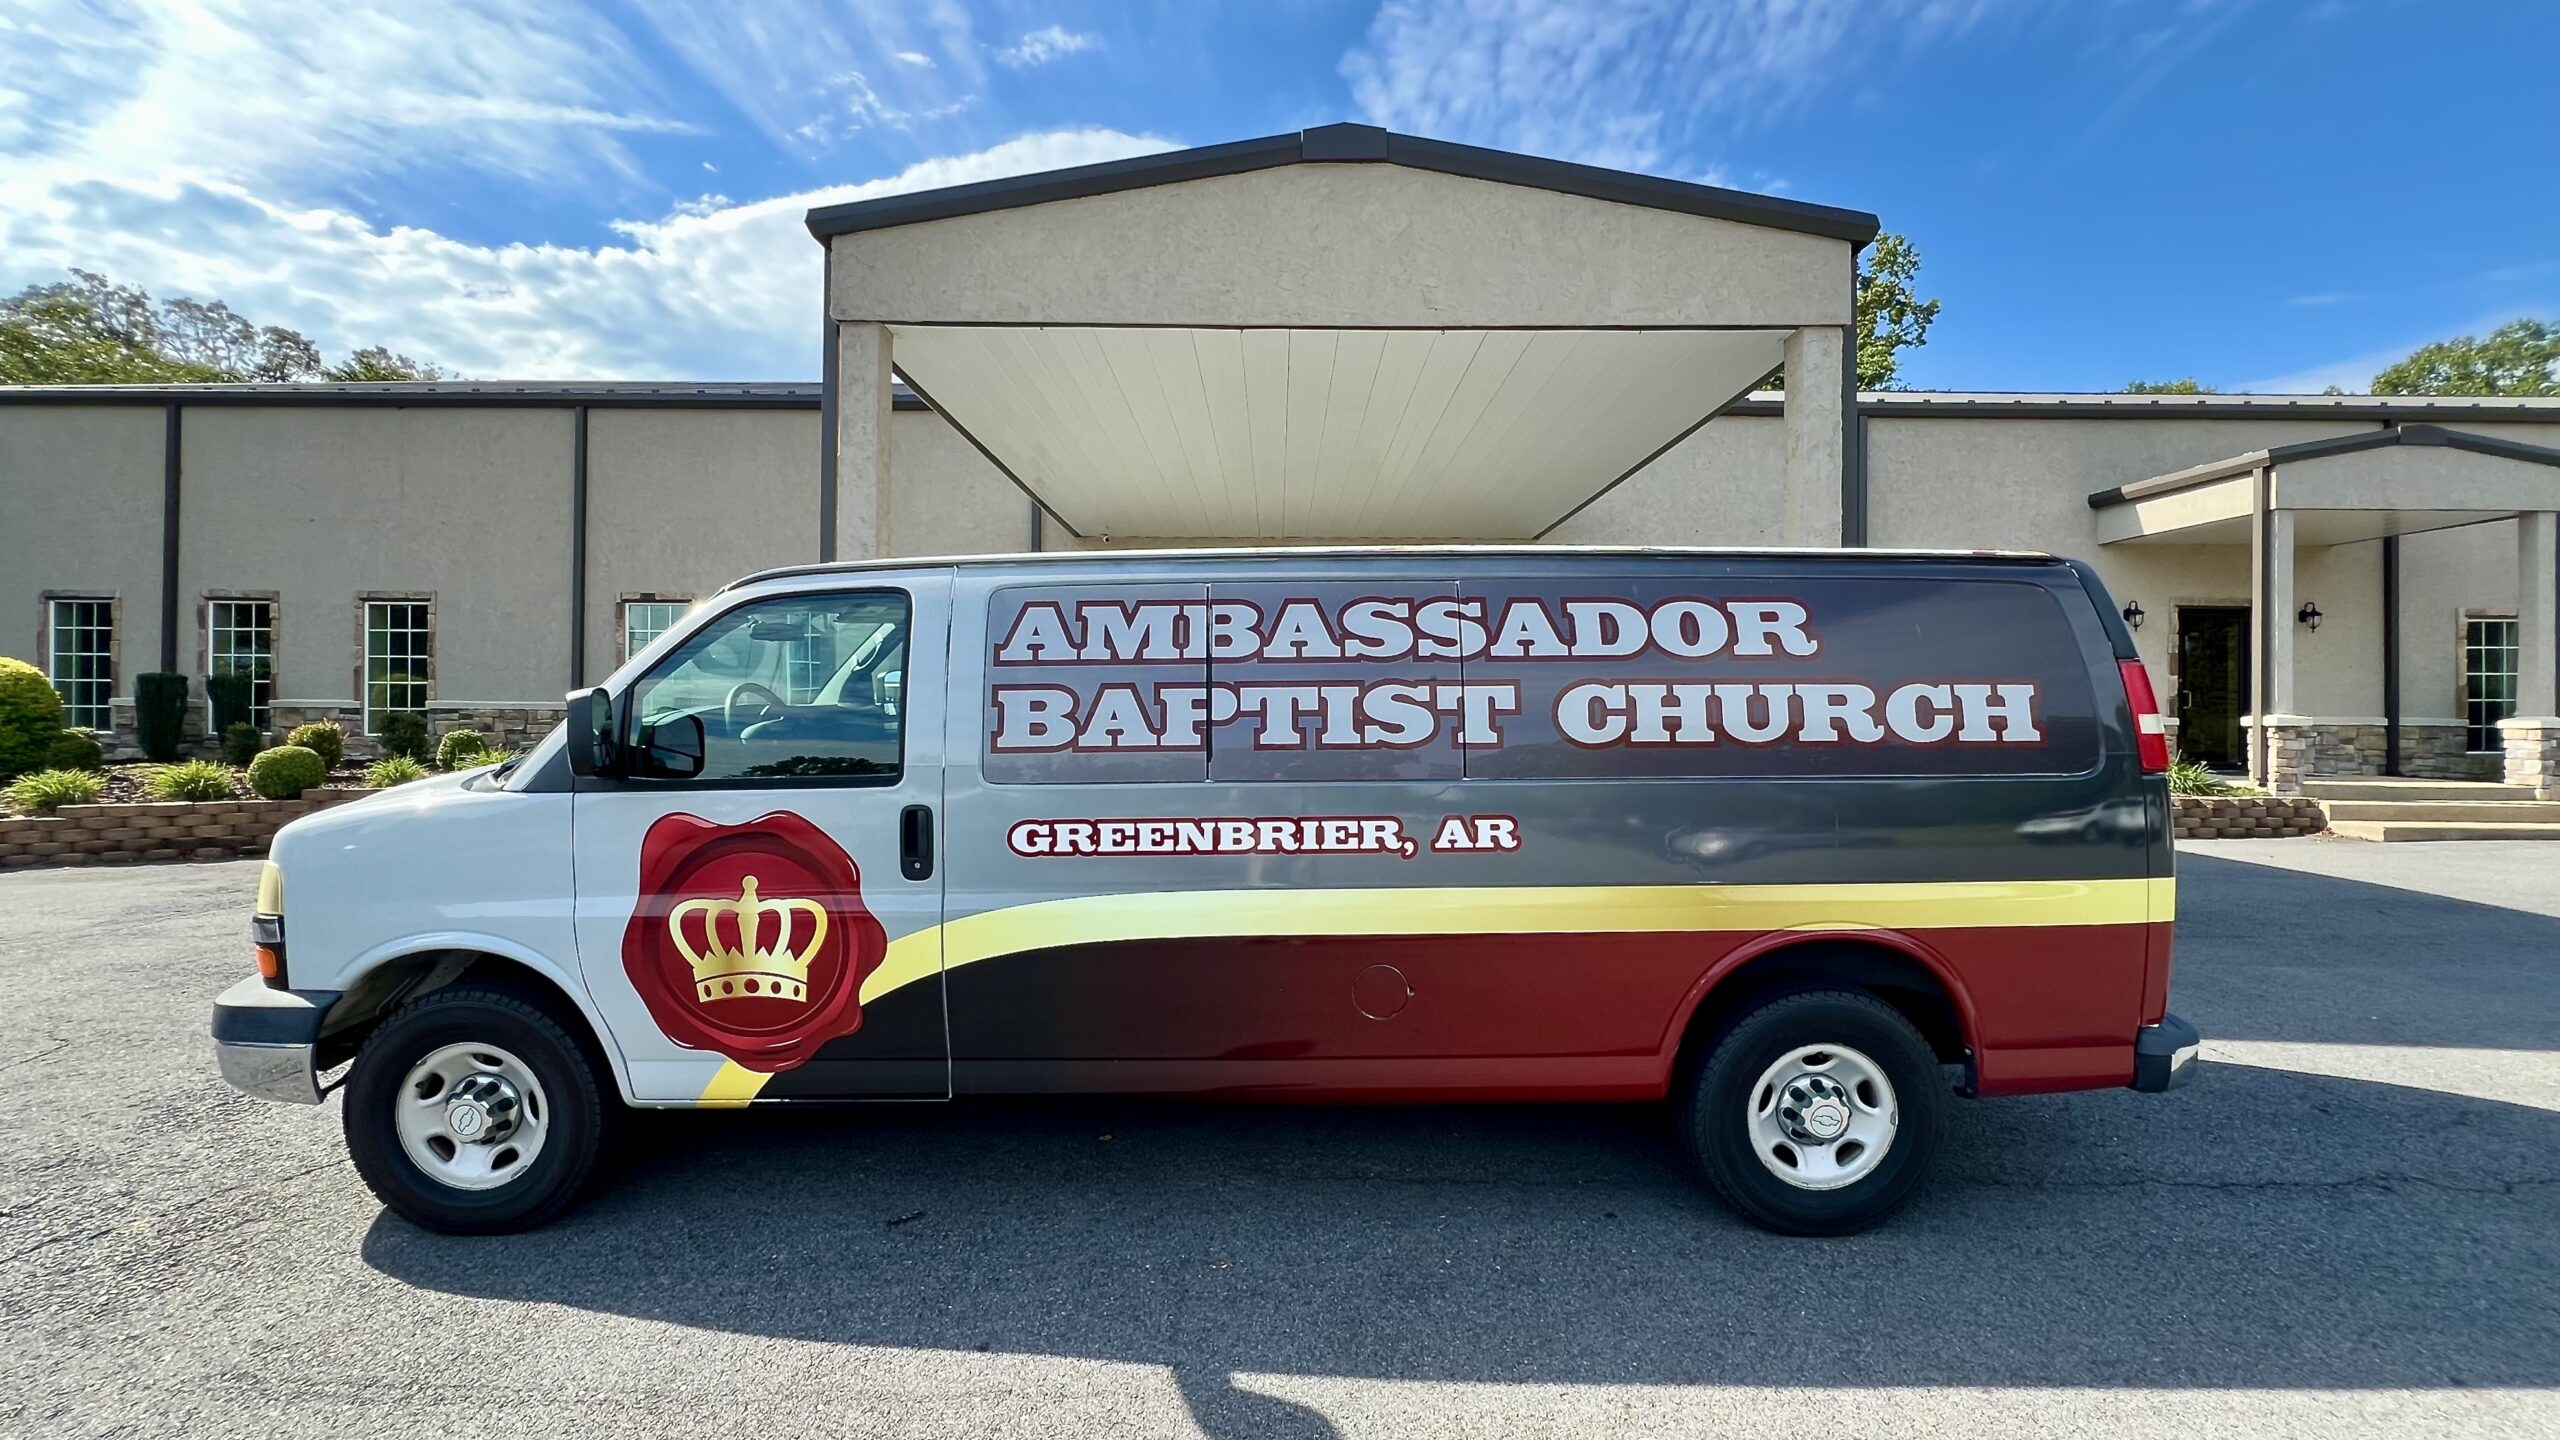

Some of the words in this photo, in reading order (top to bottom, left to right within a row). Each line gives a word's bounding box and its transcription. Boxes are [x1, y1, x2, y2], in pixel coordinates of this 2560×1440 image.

[997, 599, 1819, 662] AMBASSADOR
[995, 683, 1517, 748] BAPTIST
[1556, 682, 2042, 745] CHURCH
[1010, 817, 1416, 855] GREENBRIER,
[1433, 817, 1518, 850] AR
